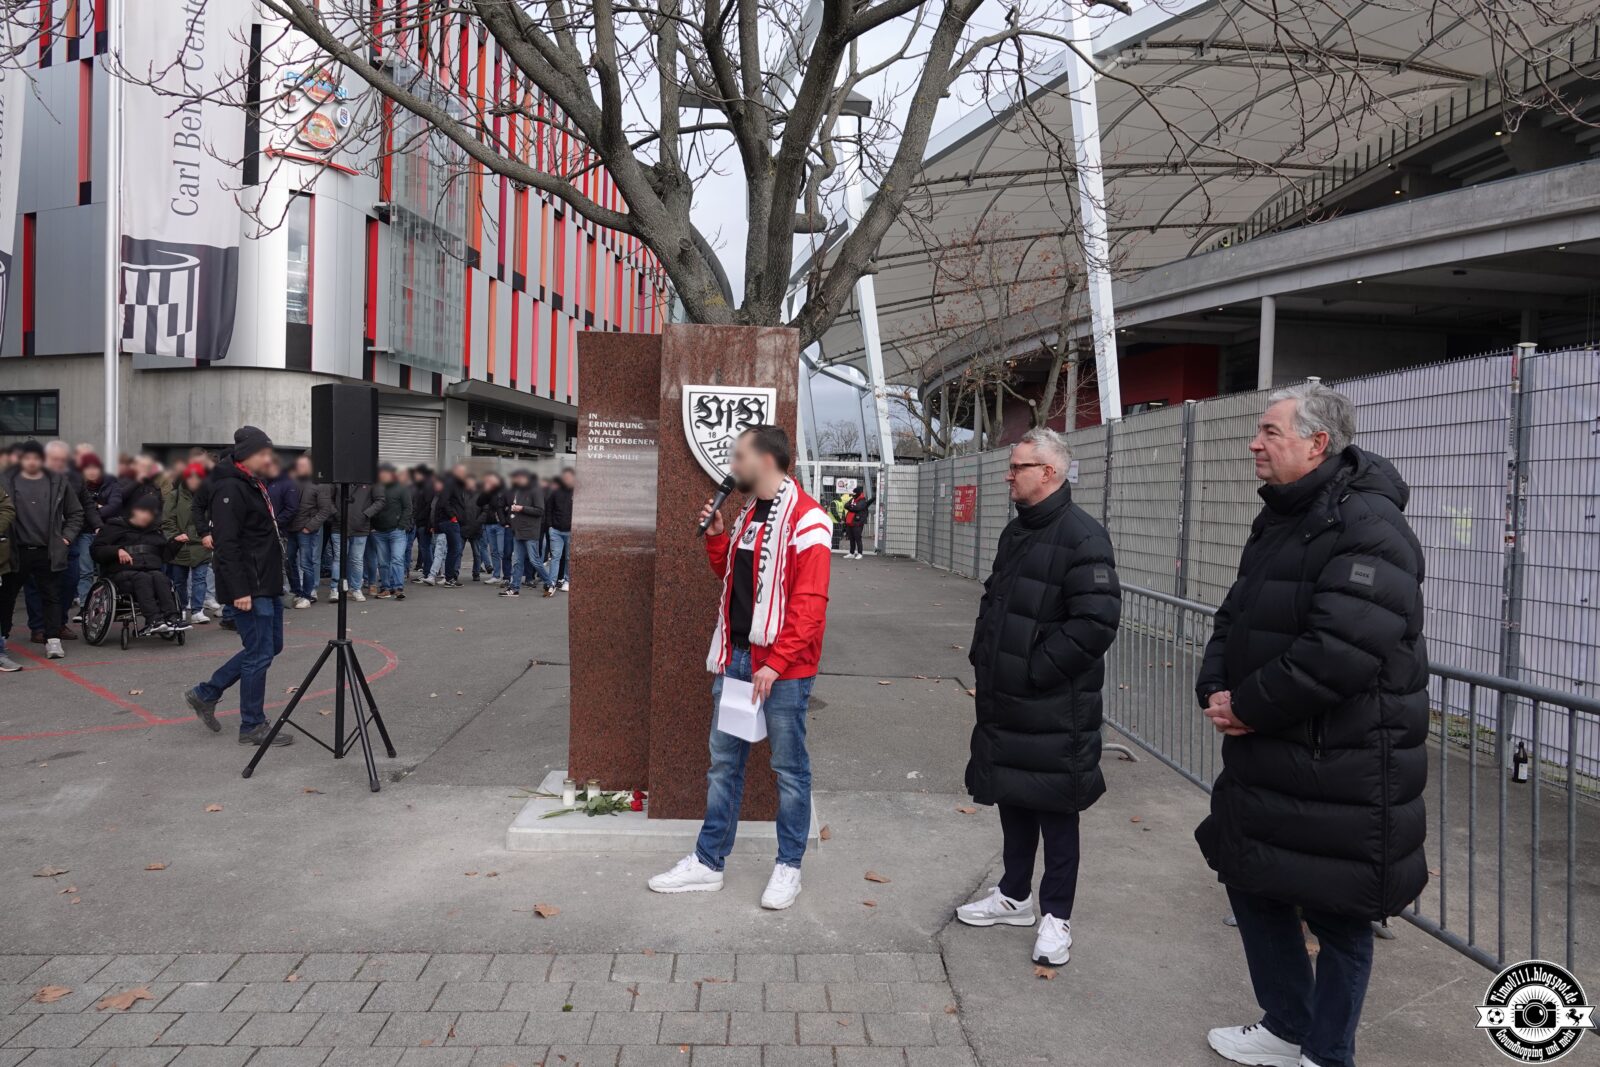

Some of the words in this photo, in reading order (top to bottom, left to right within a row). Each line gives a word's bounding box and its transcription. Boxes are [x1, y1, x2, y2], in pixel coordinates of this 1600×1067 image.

[173, 83, 203, 151] Benz
[171, 160, 200, 216] Carl
[589, 421, 643, 429] ERINNERUNG
[693, 395, 765, 432] VfB
[588, 437, 654, 445] VERSTORBENEN
